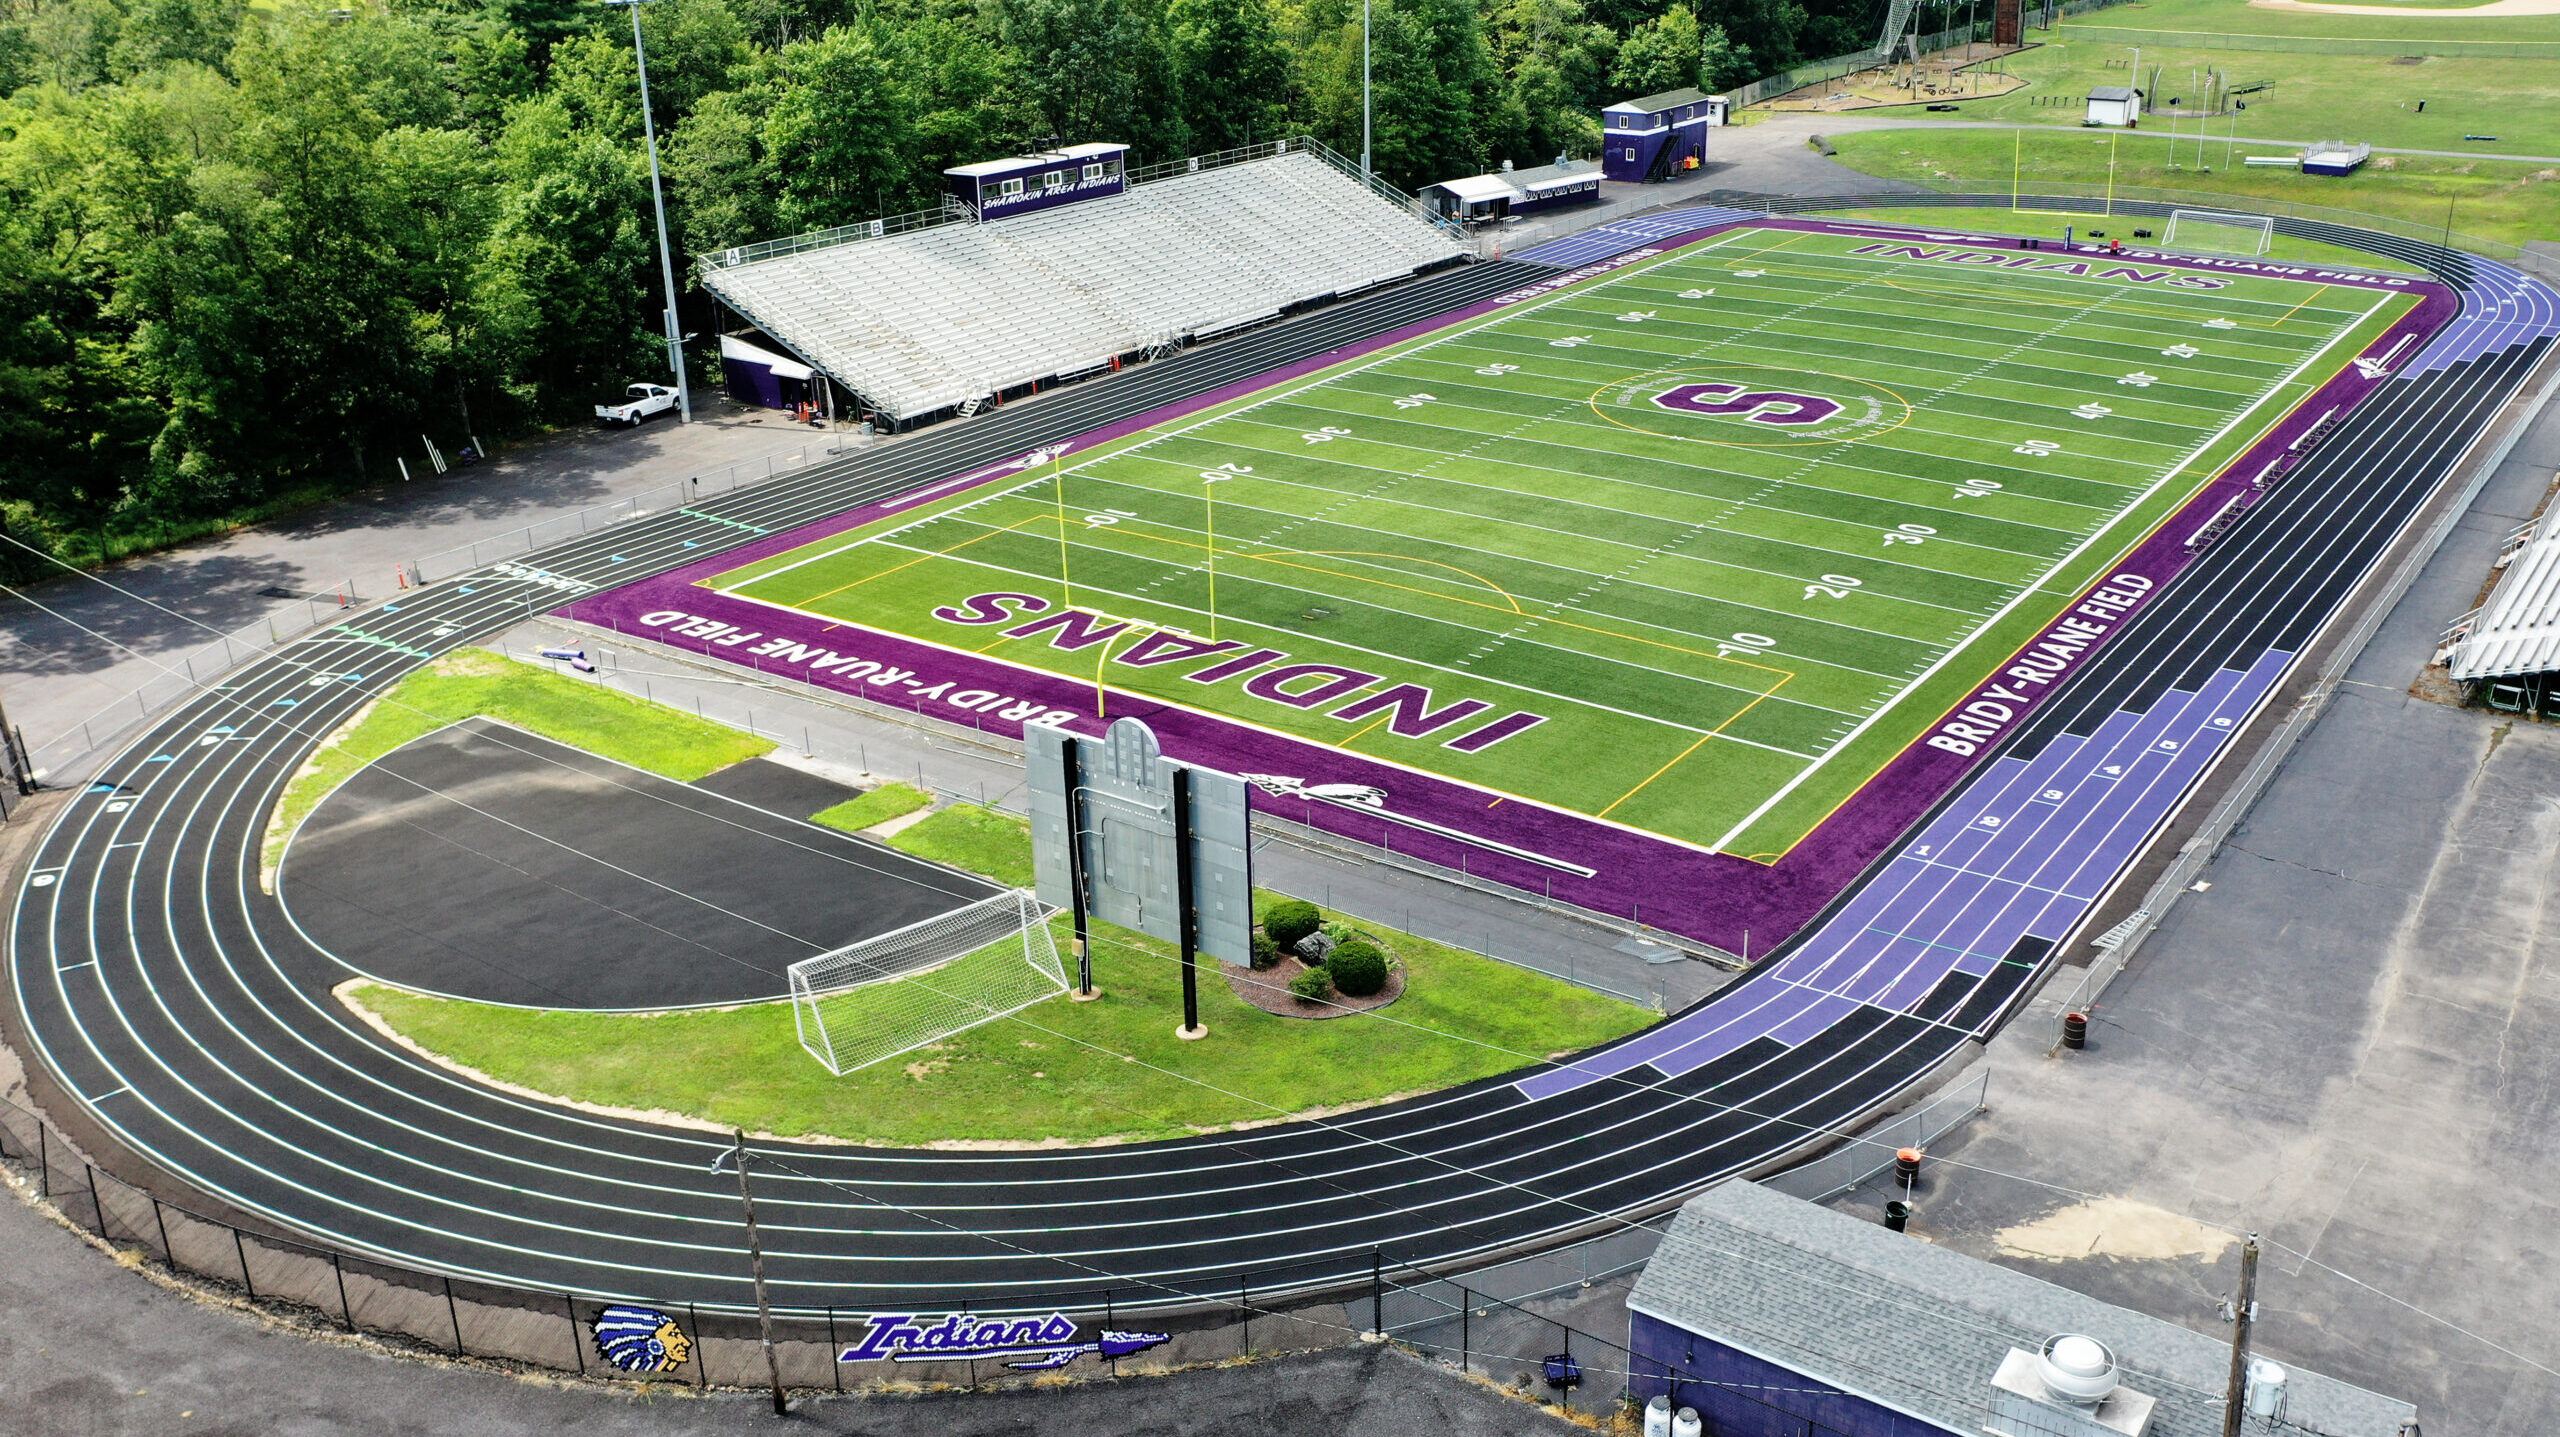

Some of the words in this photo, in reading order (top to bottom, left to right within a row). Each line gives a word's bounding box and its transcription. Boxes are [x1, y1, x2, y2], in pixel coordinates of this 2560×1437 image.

[983, 189, 1043, 209] SHAMOKIN
[1045, 183, 1075, 197] AREA
[1077, 174, 1121, 191] INDIANS
[871, 221, 882, 234] B
[729, 250, 739, 264] A
[1846, 244, 2235, 290] INDIANS
[2315, 271, 2411, 286] FIELD
[1474, 363, 1520, 376] 50
[1393, 393, 1437, 407] 40
[1648, 383, 1846, 426] S
[2070, 404, 2112, 420] 40
[1302, 426, 1352, 442] 30
[2012, 440, 2061, 457] 50
[1199, 463, 1253, 481] 20
[1955, 479, 2003, 497] 40
[1084, 508, 1138, 525] 10
[1883, 523, 1938, 545] 30
[1804, 574, 1862, 599] 20
[639, 610, 743, 647] FIELD
[1716, 632, 1777, 655] 10
[930, 592, 1551, 755] INDIANS
[1926, 616, 2108, 758] BRIDY-RUANE
[2076, 573, 2154, 621] FIELD
[746, 637, 1080, 728] BRIDY-RUANE
[2102, 764, 2123, 775] 4
[2042, 789, 2064, 801] 3
[1980, 815, 2002, 828] 2
[1914, 844, 1932, 856] 1
[837, 1311, 1078, 1363] Indians
